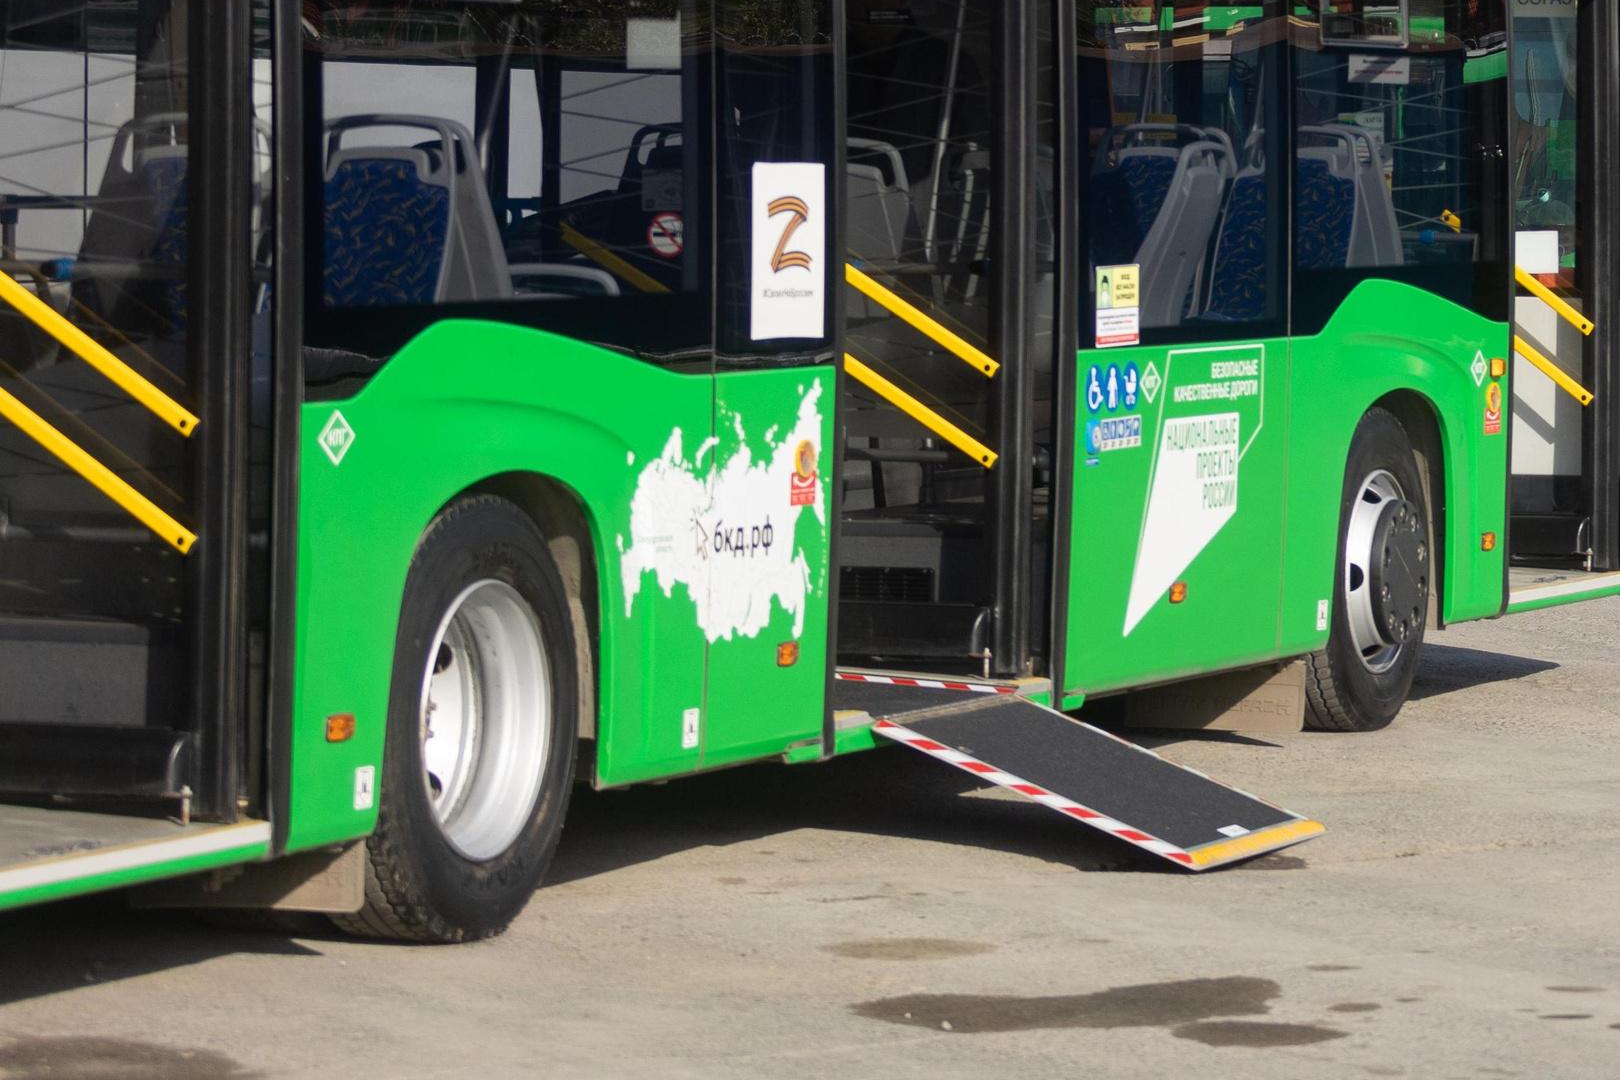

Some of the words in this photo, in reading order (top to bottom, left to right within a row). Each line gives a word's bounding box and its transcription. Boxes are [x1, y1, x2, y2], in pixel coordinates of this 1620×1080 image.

[1211, 359, 1258, 379] БЕЗОПАСНЫЕ
[1173, 381, 1230, 402] КАЧЕСТВЕННЫЕ
[1230, 379, 1258, 401] ДОРОГИ
[1166, 417, 1237, 453] НАЦИОНАЛЬНЫЕ
[1196, 449, 1237, 480] ПРОЕКТЫ
[1202, 479, 1236, 510] РОССИИ
[713, 513, 774, 558] бкд.рф
